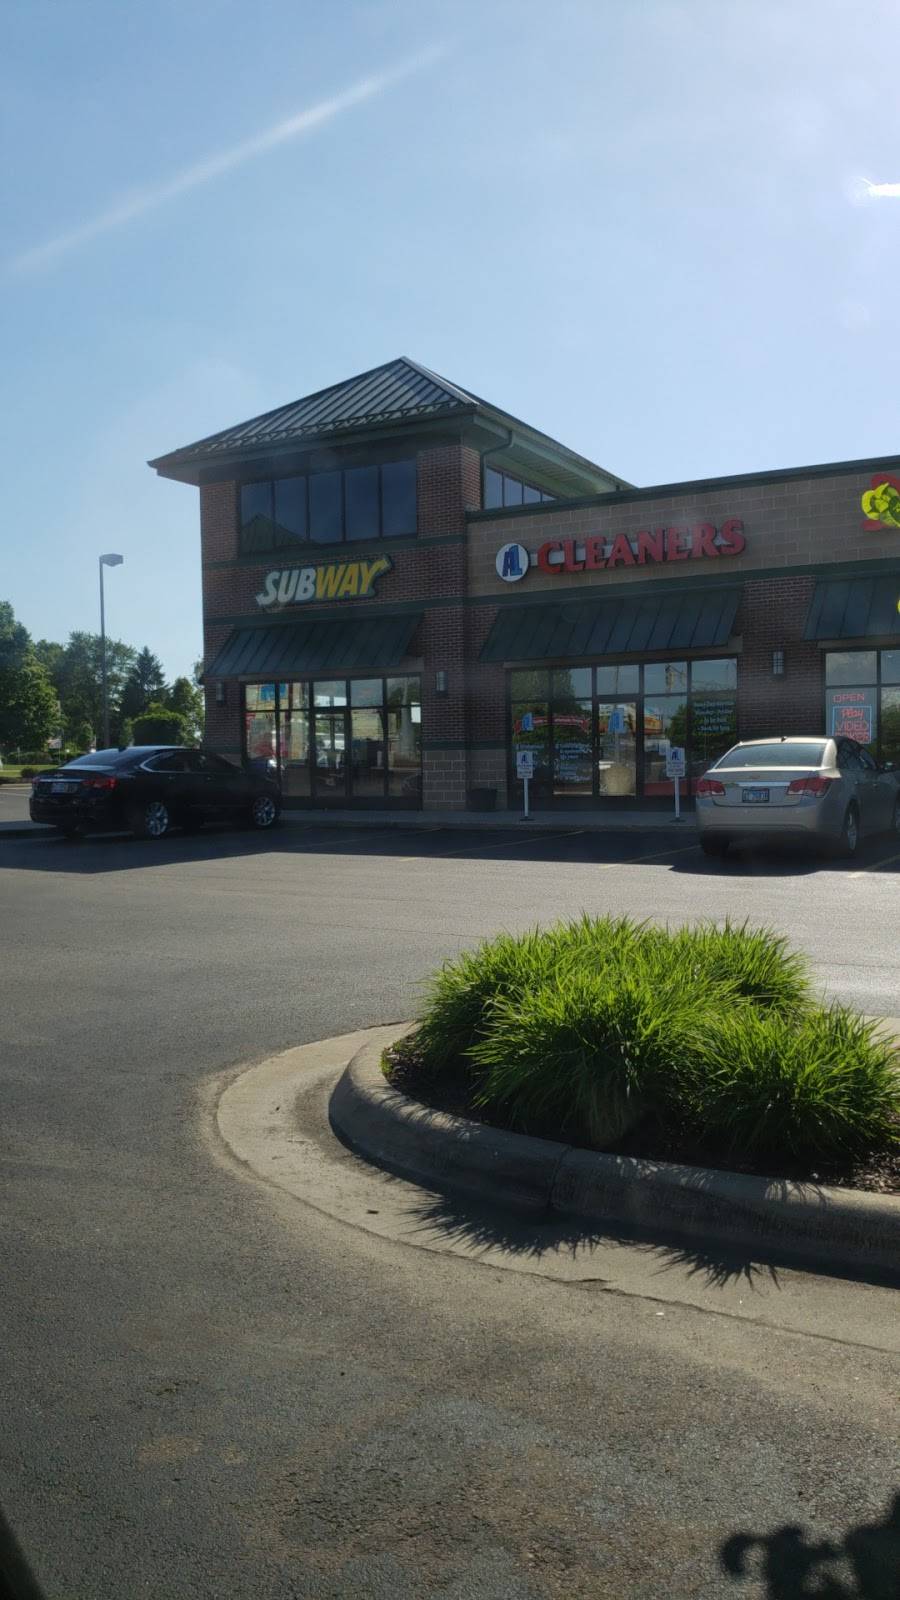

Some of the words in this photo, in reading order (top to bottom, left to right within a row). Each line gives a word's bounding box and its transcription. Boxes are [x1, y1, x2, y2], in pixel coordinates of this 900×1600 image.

[537, 519, 746, 574] CLEANERS
[255, 556, 389, 606] SUBWAY
[832, 693, 865, 703] OPEN
